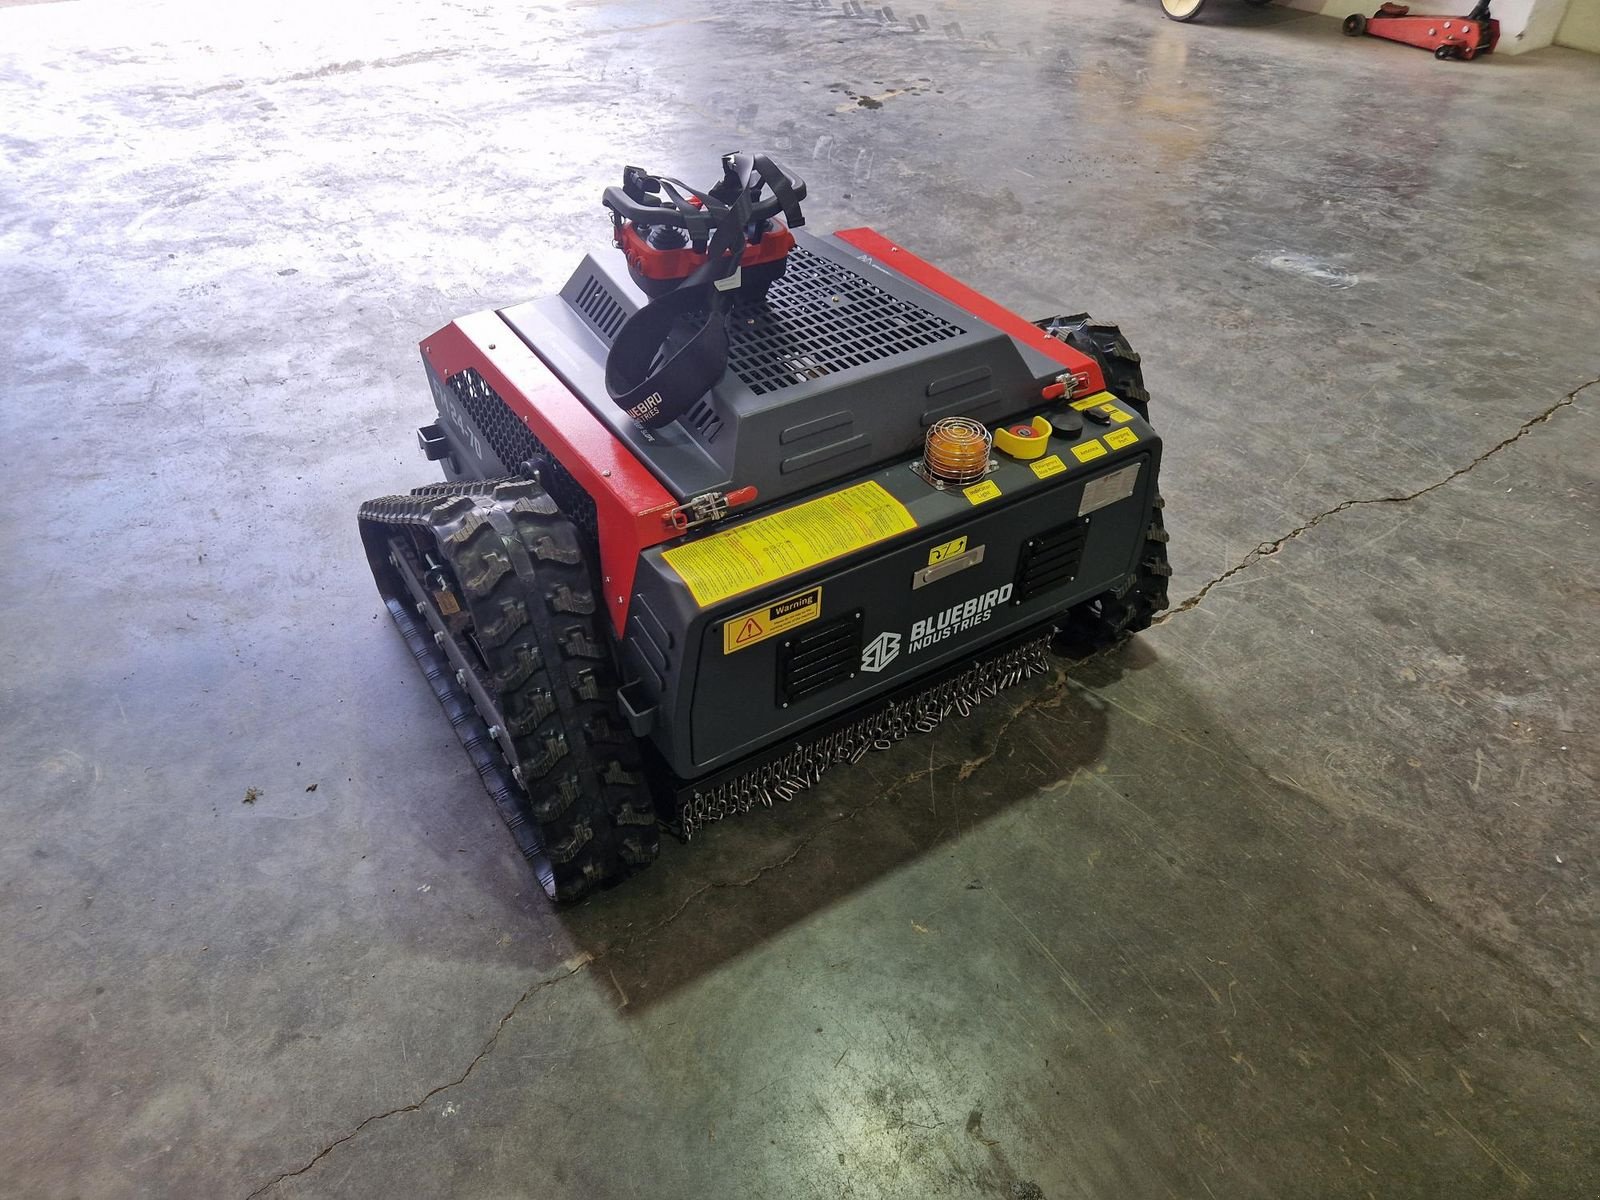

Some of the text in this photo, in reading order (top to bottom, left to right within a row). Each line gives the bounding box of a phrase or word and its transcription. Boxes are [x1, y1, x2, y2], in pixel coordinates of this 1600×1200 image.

[775, 595, 814, 615] Warning
[910, 583, 1013, 642] BLUEBIRD
[908, 609, 992, 654] INDUSTRIES
